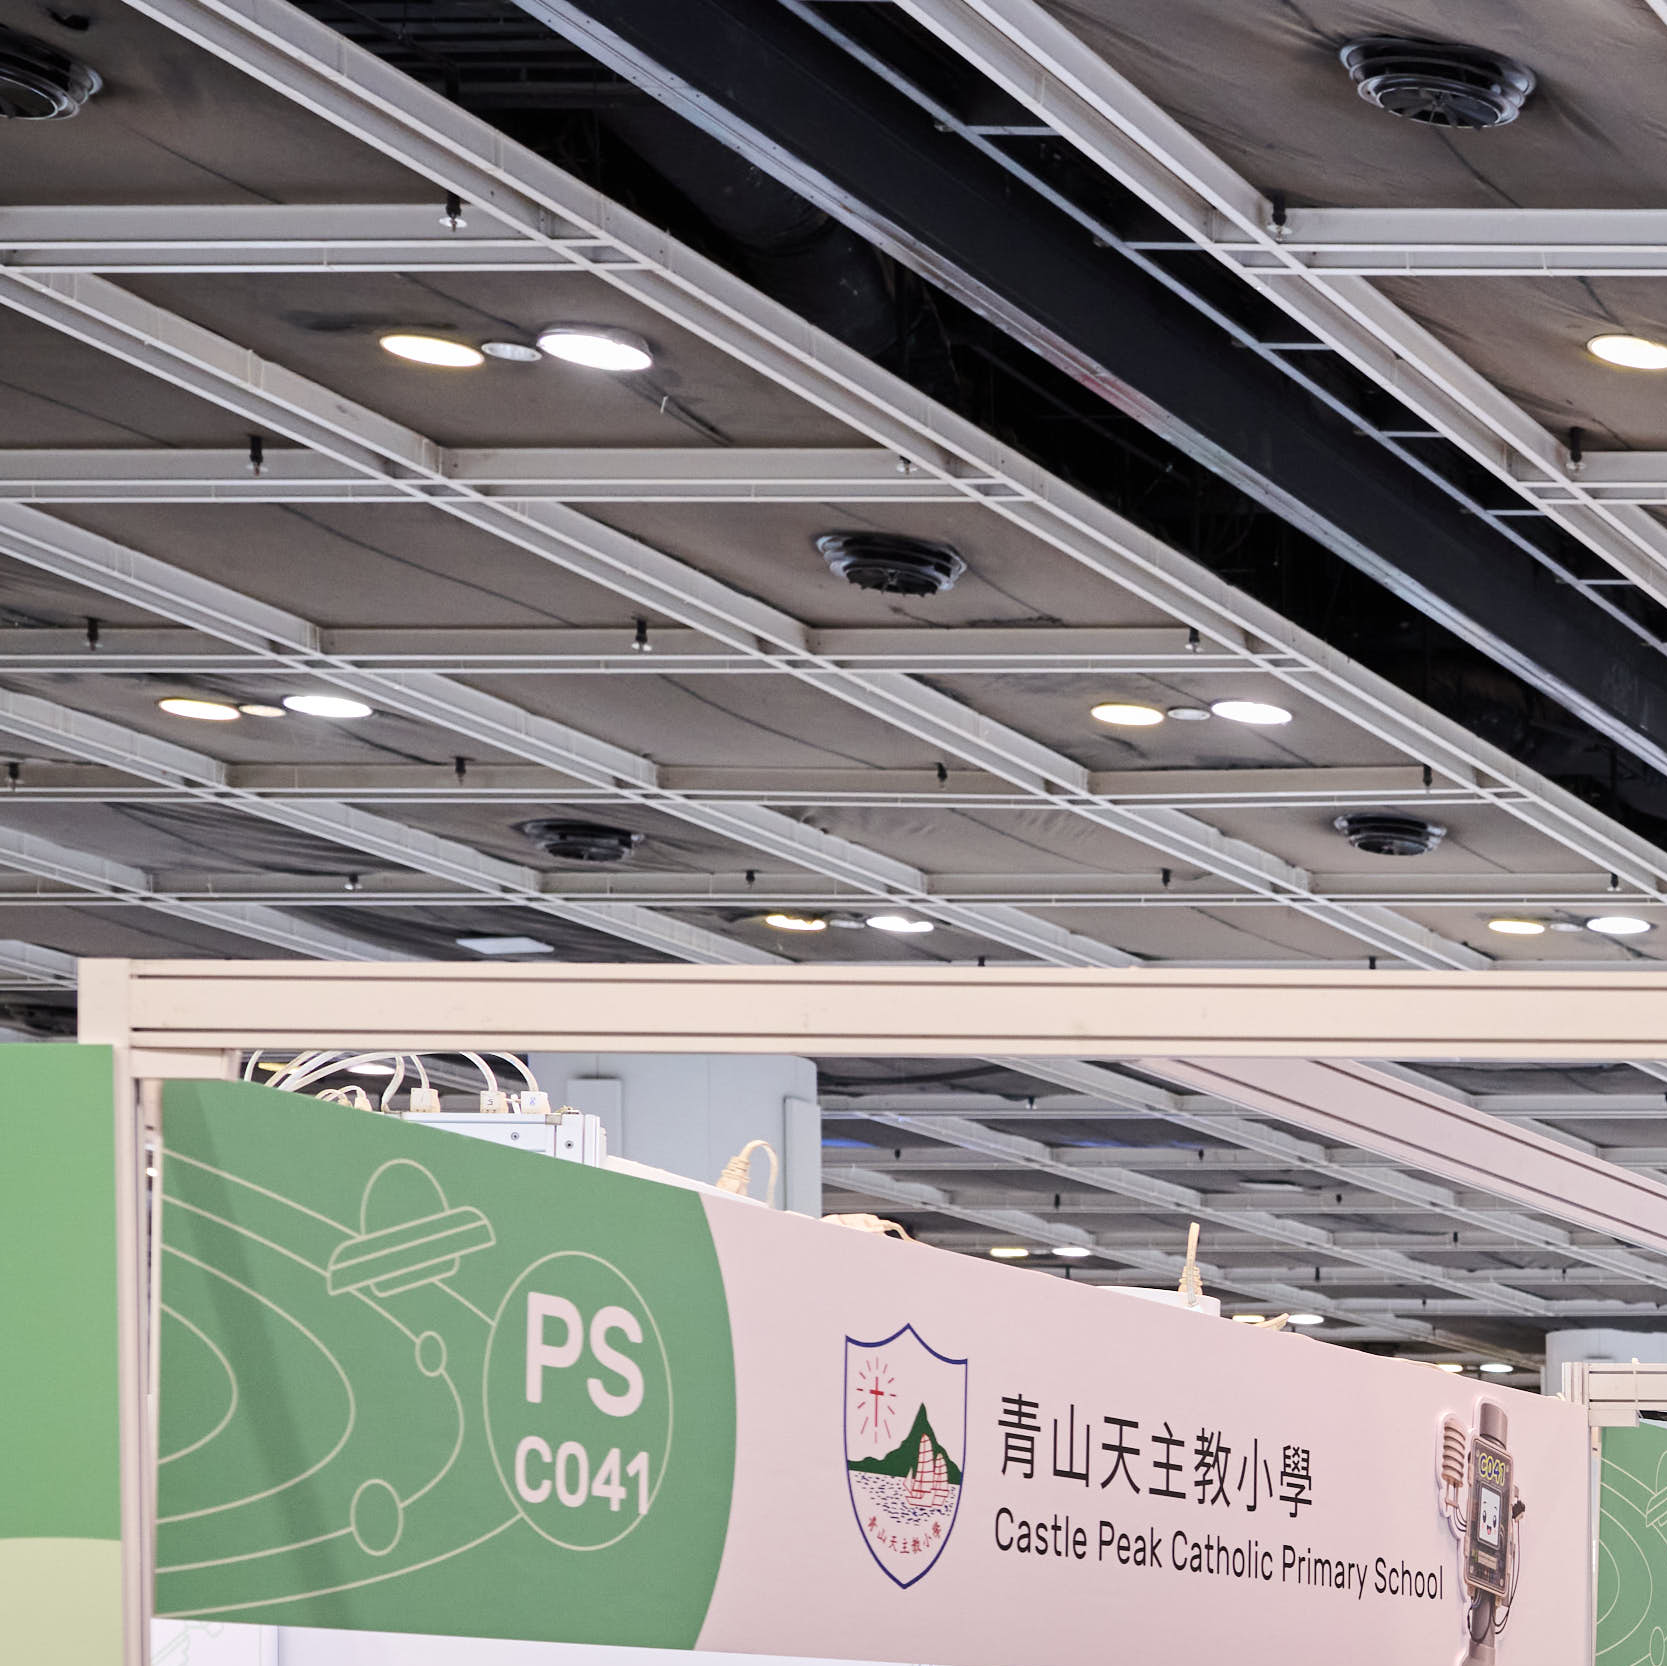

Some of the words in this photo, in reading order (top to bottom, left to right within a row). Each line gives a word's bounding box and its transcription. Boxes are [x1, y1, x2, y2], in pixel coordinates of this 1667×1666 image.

[526, 1291, 645, 1417] PS
[514, 1436, 651, 1515] C041
[997, 1393, 1313, 1519] 青山天主教小學
[1478, 1452, 1506, 1486] C041
[995, 1506, 1088, 1560] Castle
[1099, 1519, 1163, 1568] Peak
[1171, 1530, 1273, 1582] Catholic
[1281, 1543, 1368, 1601] Primary
[1374, 1557, 1444, 1601] School
